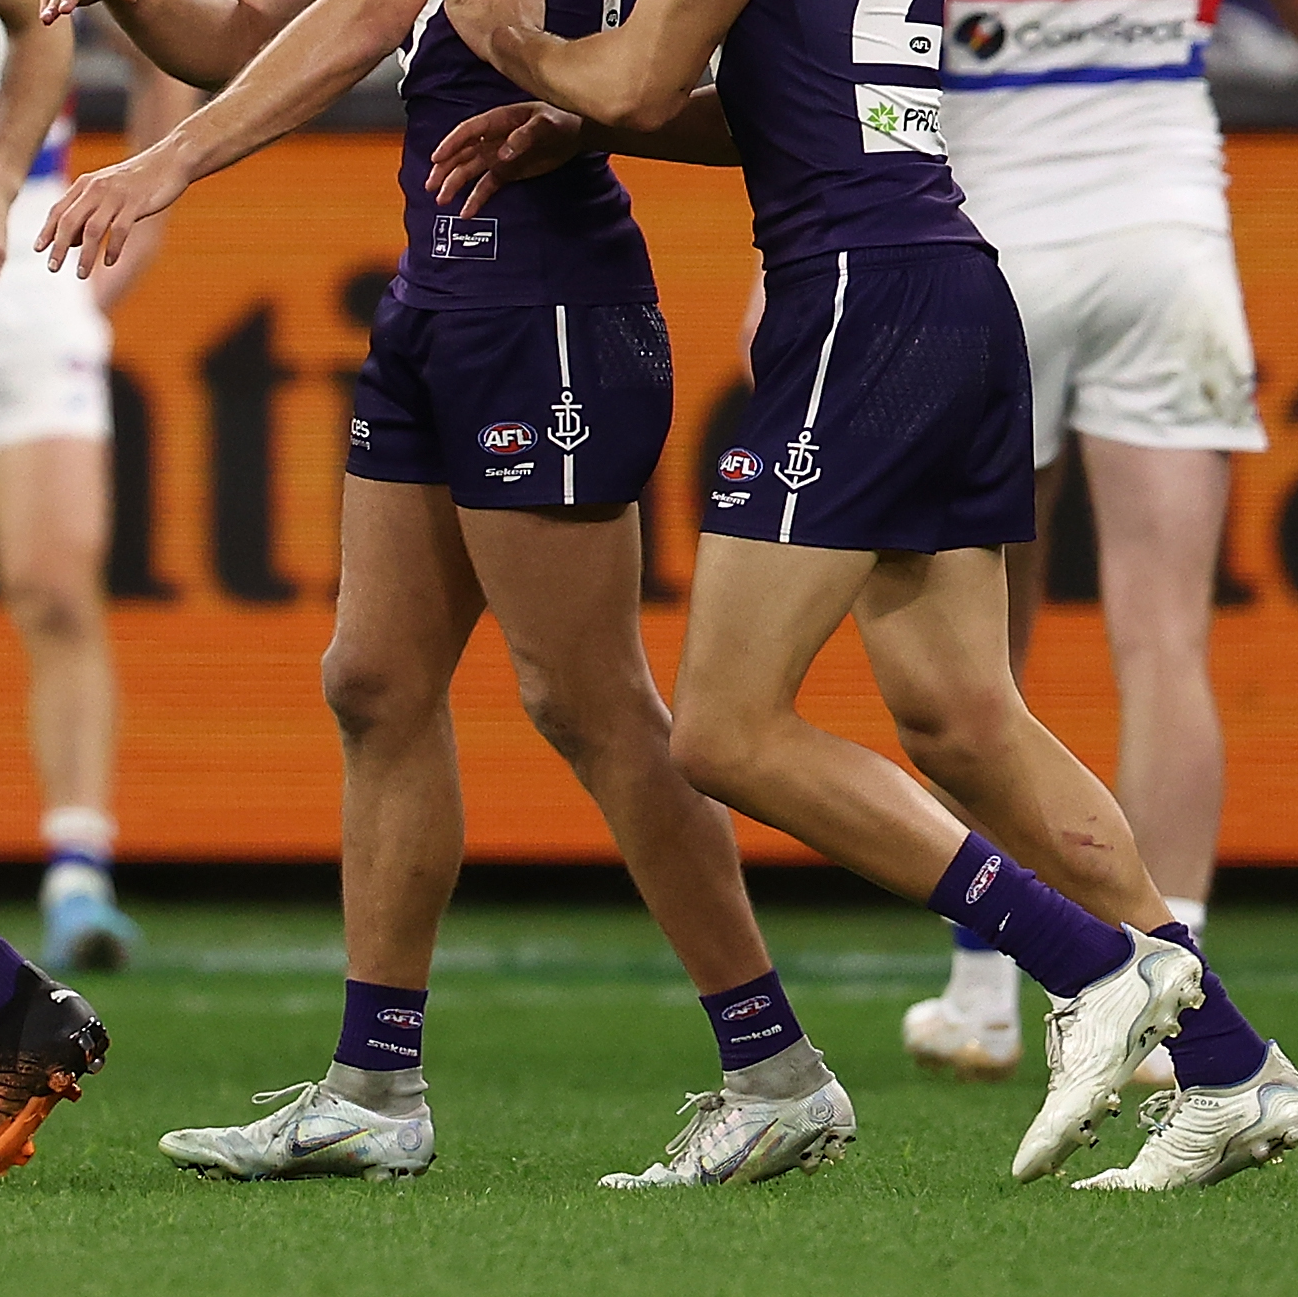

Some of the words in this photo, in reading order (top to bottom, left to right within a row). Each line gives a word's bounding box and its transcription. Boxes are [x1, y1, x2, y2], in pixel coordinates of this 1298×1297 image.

[484, 428, 532, 447] AFL
[485, 467, 532, 478] Sekem
[719, 455, 756, 476] AFL
[711, 491, 746, 506] Sekem
[1193, 1098, 1220, 1107] COPA
